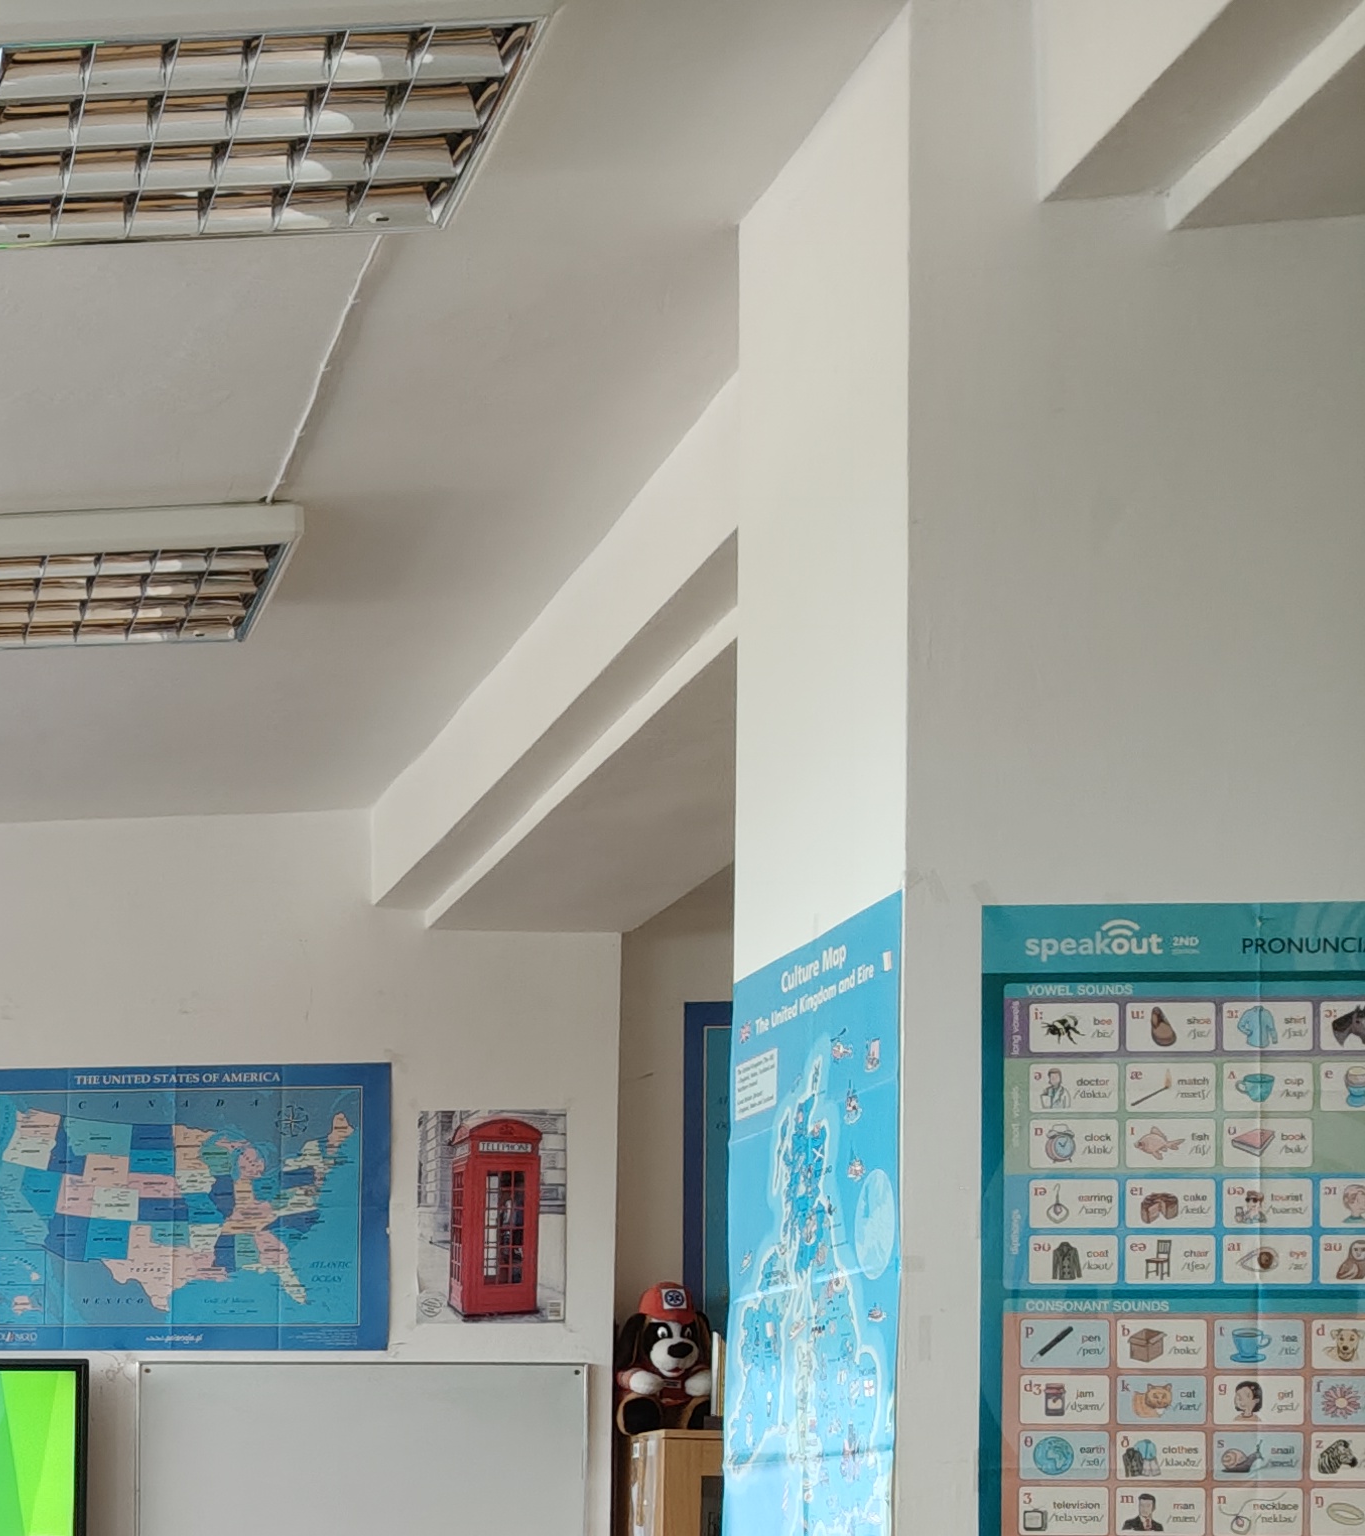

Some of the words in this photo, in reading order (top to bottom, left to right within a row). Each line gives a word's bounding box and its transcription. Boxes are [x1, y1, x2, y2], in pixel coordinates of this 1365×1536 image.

[1025, 931, 1163, 962] speakout
[1172, 936, 1200, 946] 2ND
[781, 960, 819, 992] Culture
[822, 945, 847, 972] Map
[1026, 985, 1073, 996] VOWEL
[1077, 984, 1134, 996] SOUNDS
[755, 1018, 769, 1035] The
[771, 1001, 798, 1028] United
[799, 986, 837, 1012] Kingdom
[838, 970, 855, 994] and
[857, 964, 874, 984] Eire
[1093, 1017, 1112, 1026] bee
[75, 1075, 99, 1085] THE
[103, 1075, 150, 1085] UNITED
[154, 1073, 199, 1084] STATES
[202, 1073, 219, 1083] OF
[223, 1072, 280, 1083] AMERICA
[1076, 1078, 1109, 1086] doctor
[1177, 1077, 1210, 1086] match
[1284, 1078, 1304, 1087] cup
[1084, 1133, 1111, 1141] clock
[1281, 1132, 1306, 1141] book
[1078, 1193, 1113, 1203] earring
[1183, 1193, 1207, 1201] cake
[1271, 1193, 1303, 1201] tourist
[1086, 1250, 1109, 1258] coat
[1184, 1250, 1209, 1258] chair
[1025, 1301, 1109, 1311] CONSONANT
[1113, 1301, 1169, 1311] SOUNDS
[1025, 1326, 1034, 1338] p
[1121, 1325, 1130, 1336] b
[1316, 1325, 1325, 1336] d
[1081, 1334, 1101, 1343] pen
[1175, 1334, 1194, 1342] box
[1121, 1380, 1130, 1391] k
[1076, 1389, 1094, 1399] jam
[1180, 1389, 1196, 1398] cat
[1217, 1440, 1224, 1448] s
[1315, 1440, 1323, 1448] z
[1080, 1445, 1105, 1454] earth
[1162, 1445, 1198, 1454] clothes
[1120, 1495, 1134, 1503] m
[1217, 1495, 1226, 1504] n
[1053, 1501, 1100, 1509] television
[1173, 1502, 1195, 1510] man
[1253, 1502, 1299, 1511] necklace
